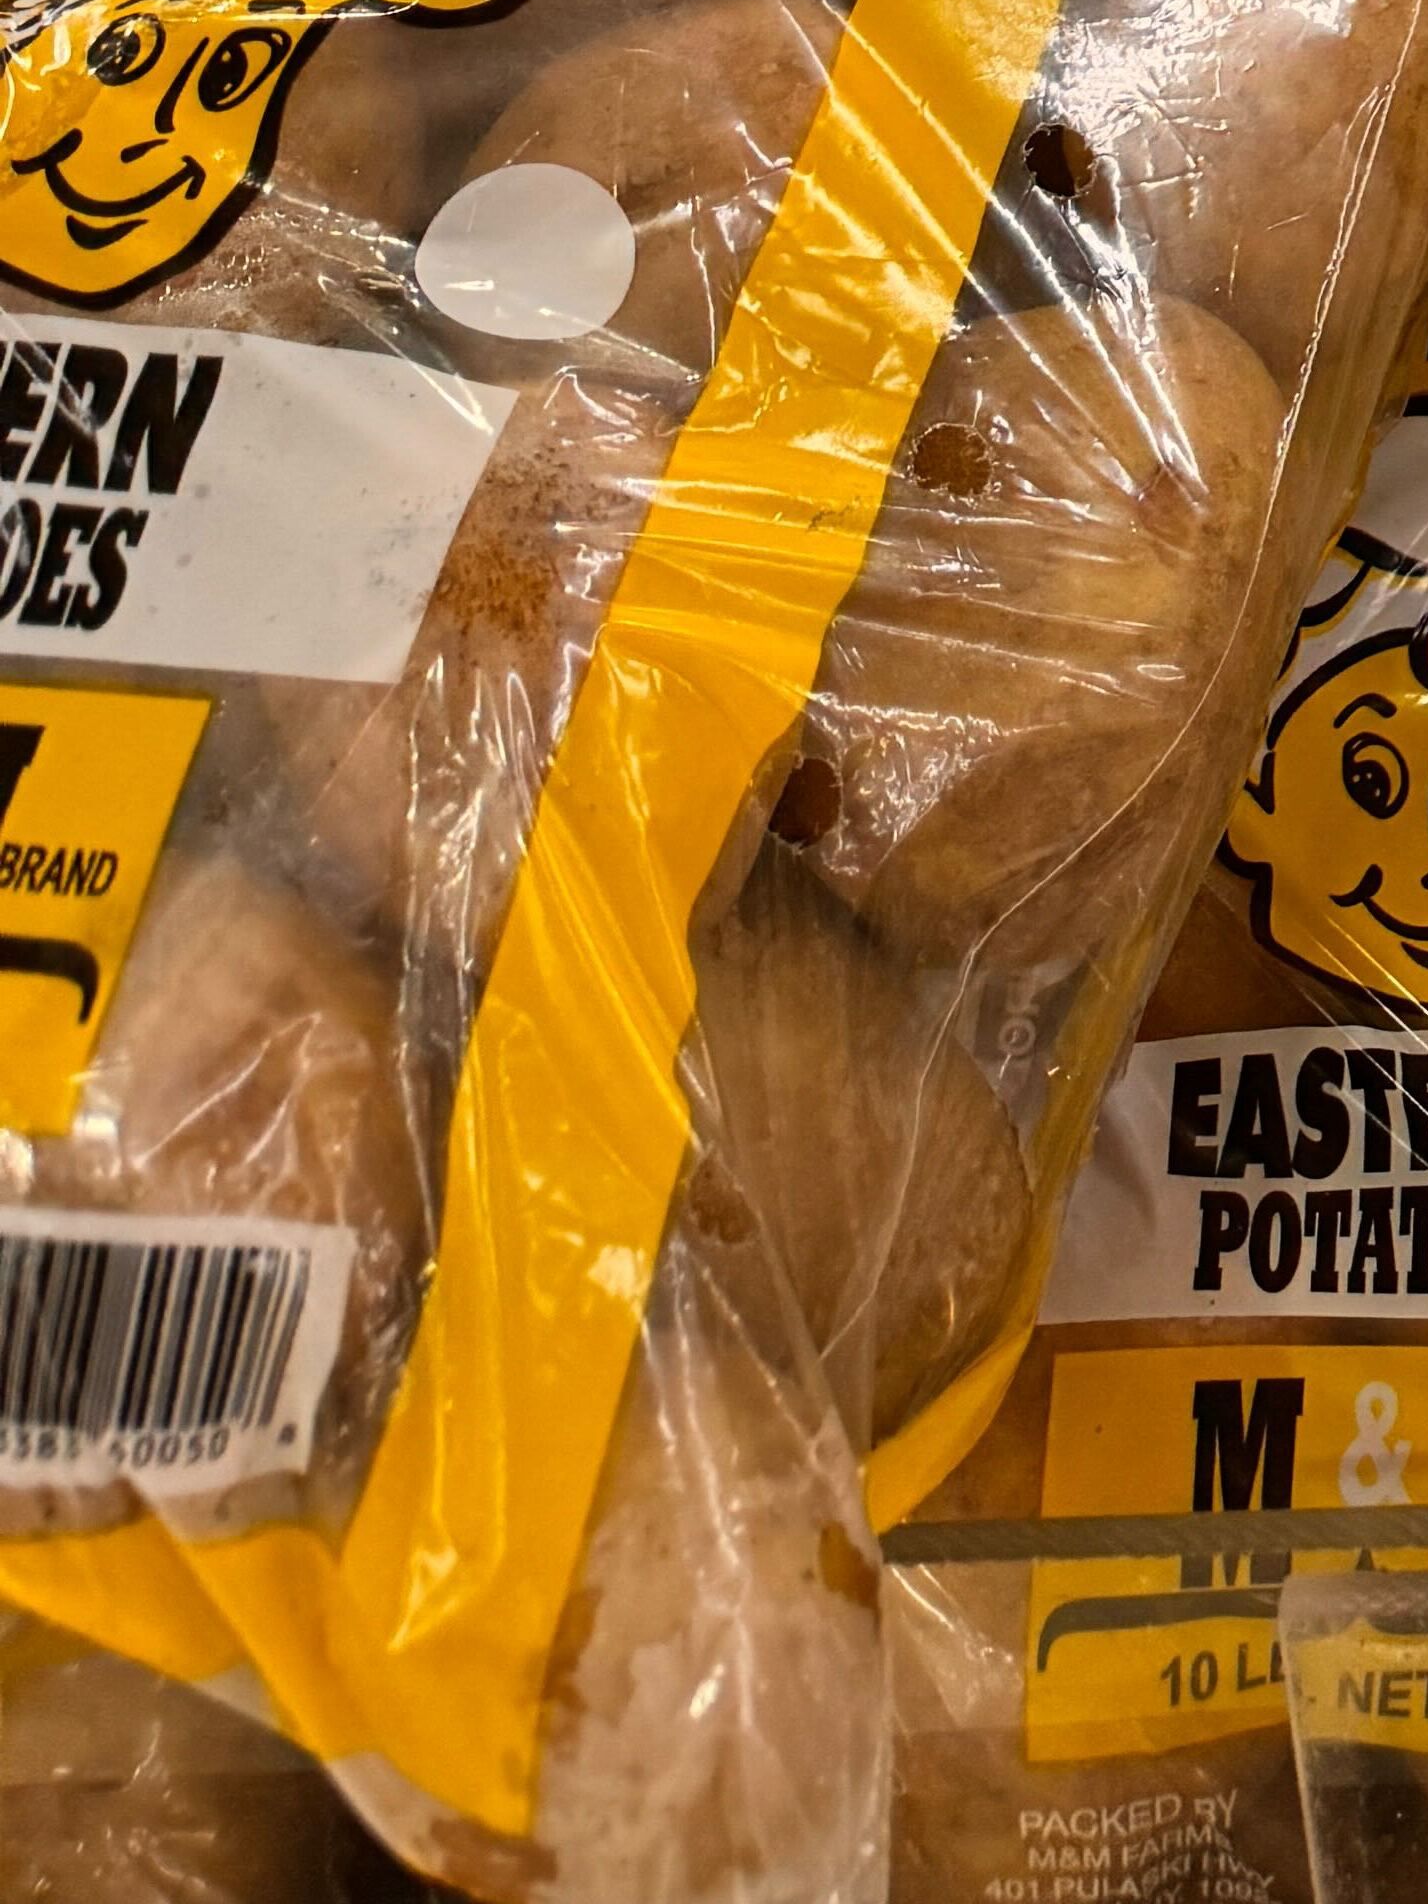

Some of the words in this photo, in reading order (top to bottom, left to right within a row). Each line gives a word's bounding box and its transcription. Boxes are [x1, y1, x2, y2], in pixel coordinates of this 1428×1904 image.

[1160, 1651, 1220, 1709] 10
[1018, 1794, 1183, 1840] PACKED
[1194, 1788, 1238, 1829] BY
[1028, 1845, 1110, 1871] M&M
[985, 1878, 1039, 1902] 401
